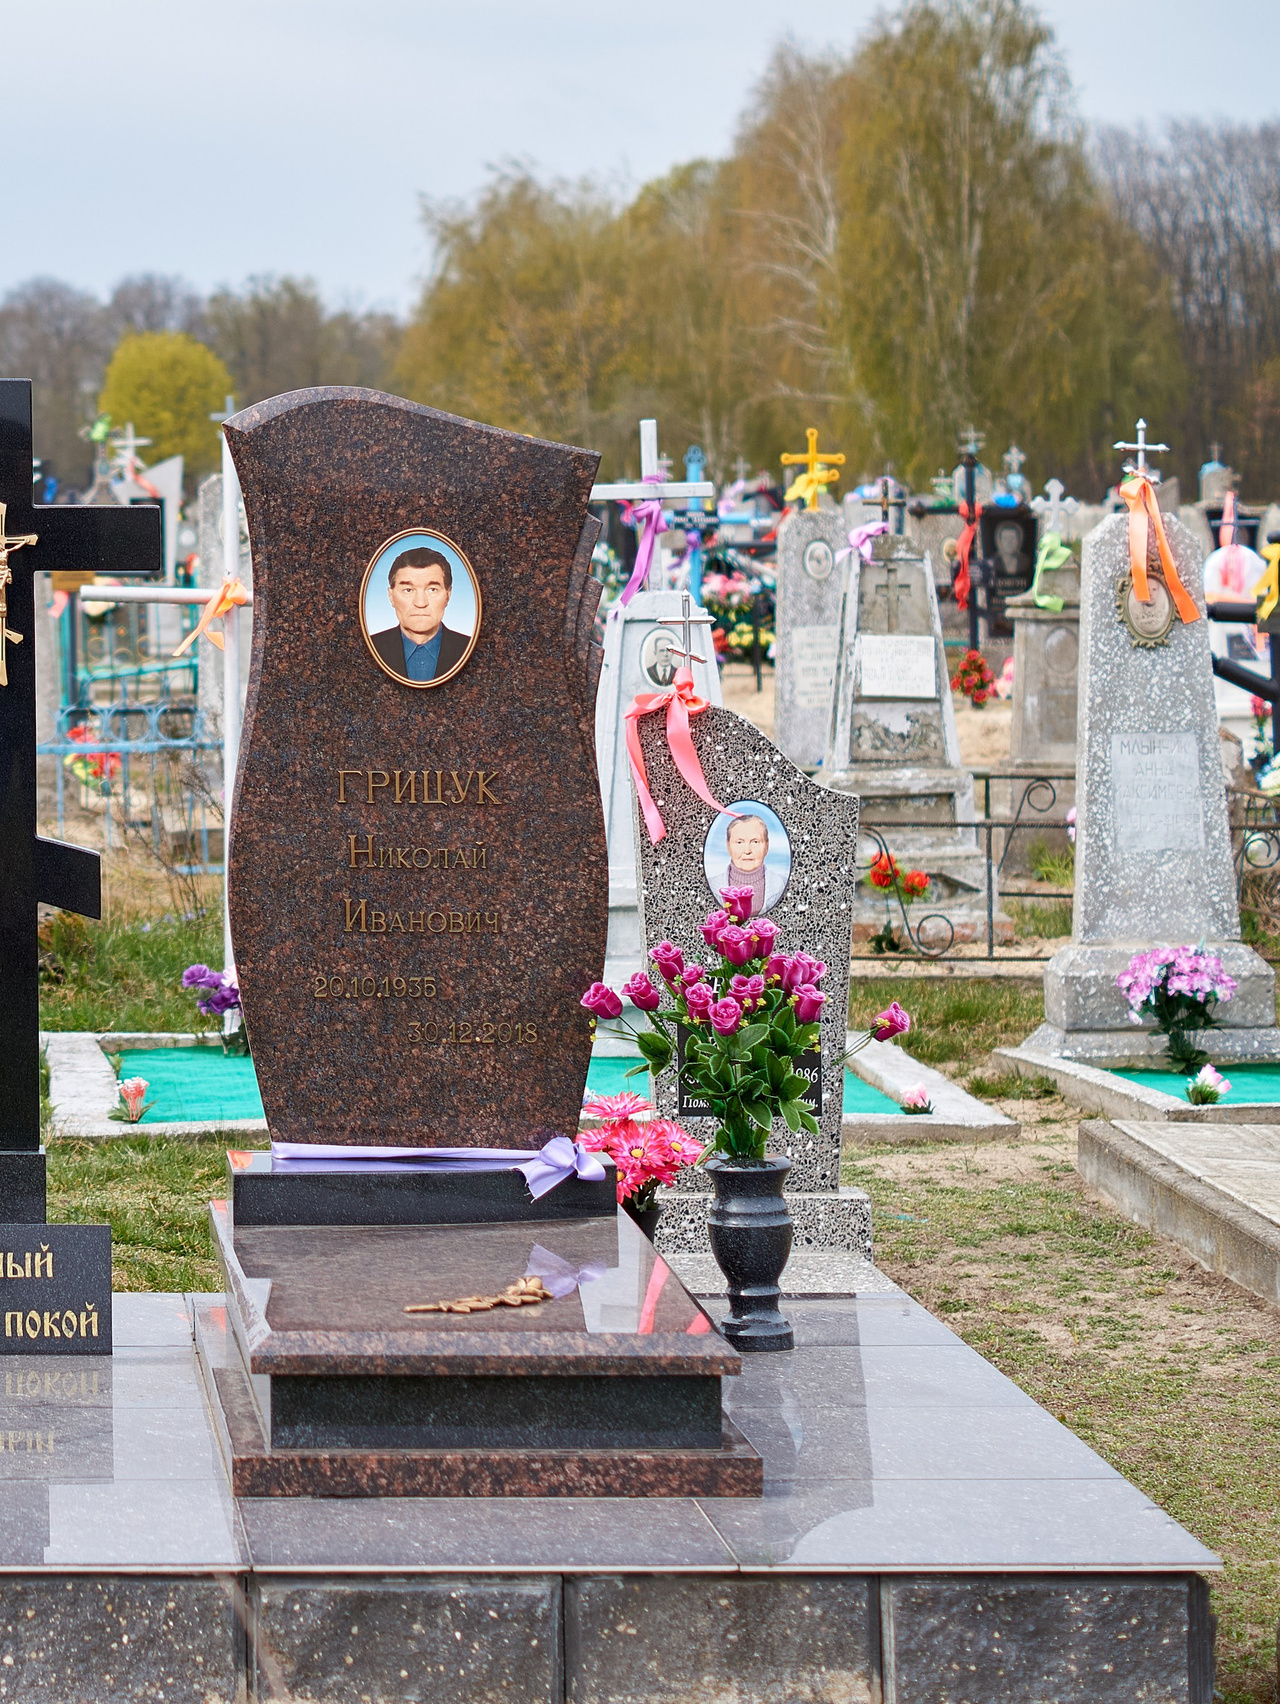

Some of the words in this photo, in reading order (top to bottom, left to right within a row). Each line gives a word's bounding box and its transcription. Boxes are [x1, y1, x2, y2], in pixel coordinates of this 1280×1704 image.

[336, 769, 503, 806] ГРИЦУК
[313, 976, 437, 1000] 20.10.1935
[407, 1021, 538, 1045] 30.12.2018
[4, 1301, 99, 1339] покой
